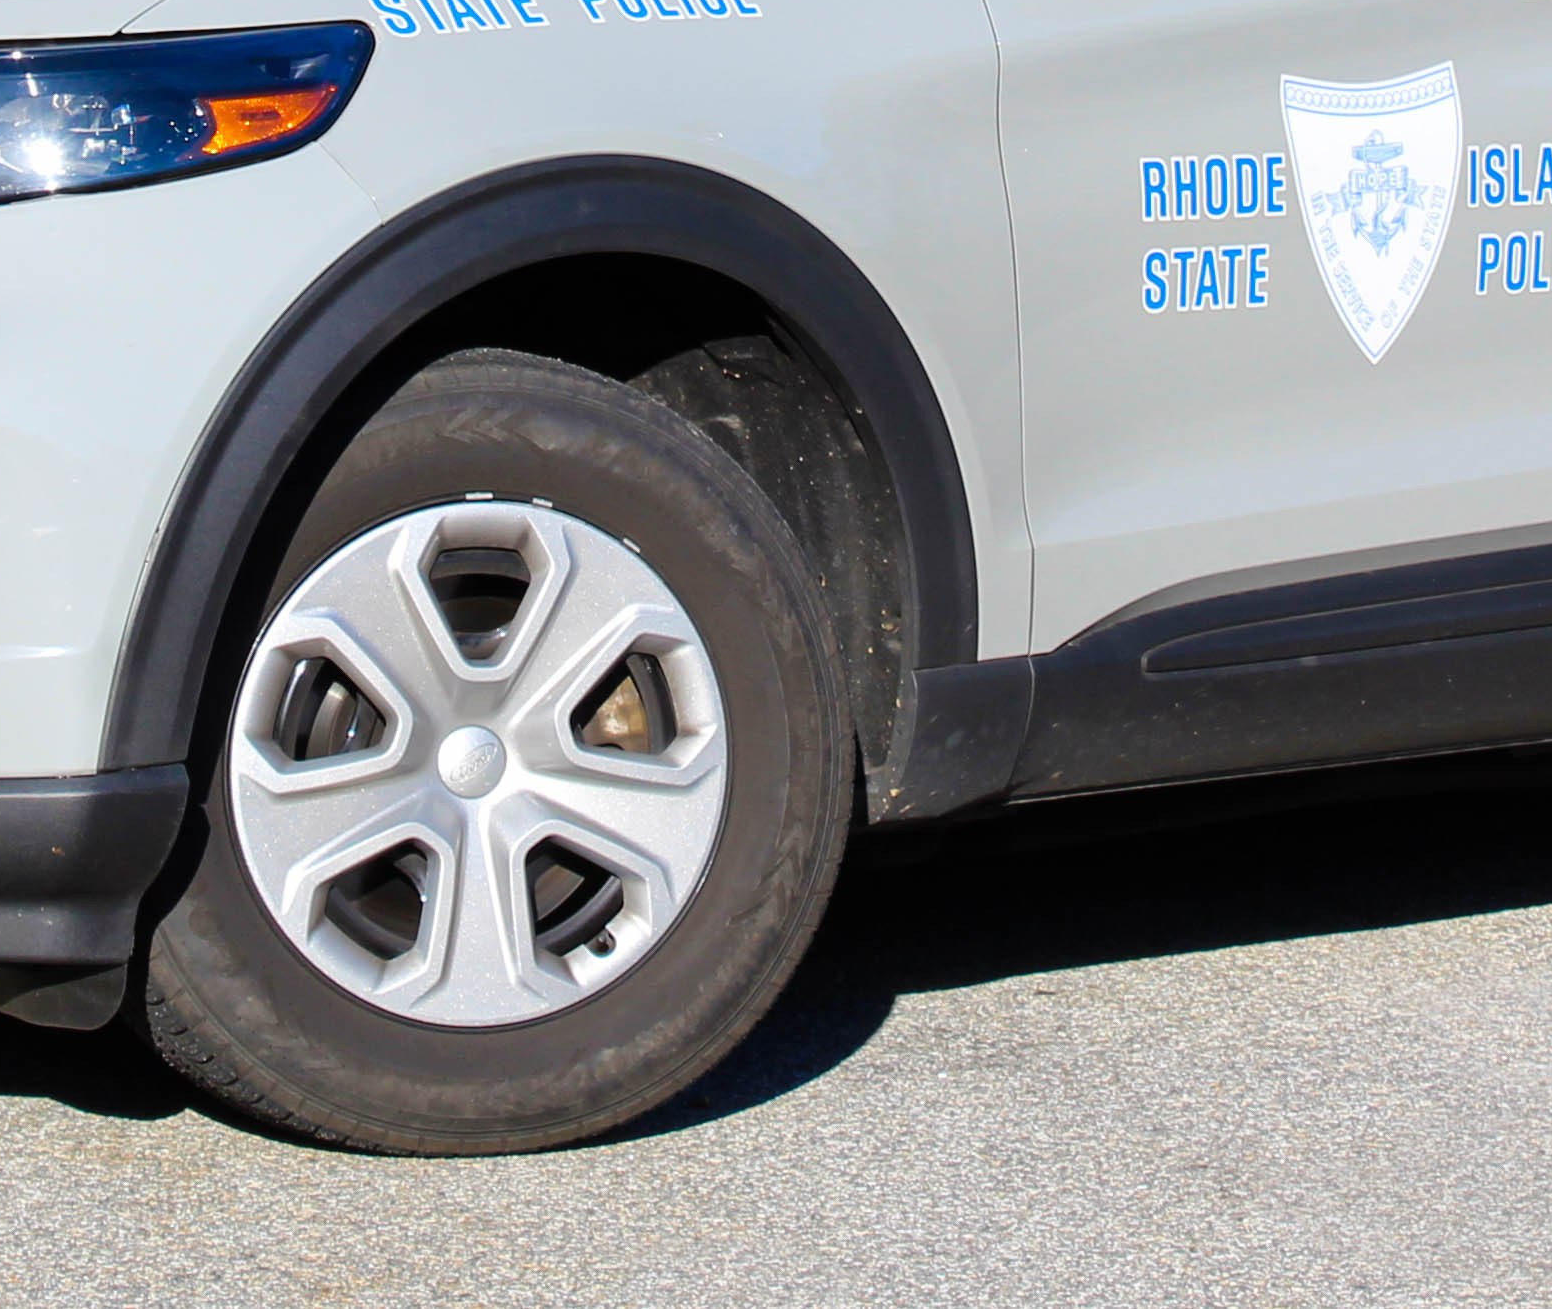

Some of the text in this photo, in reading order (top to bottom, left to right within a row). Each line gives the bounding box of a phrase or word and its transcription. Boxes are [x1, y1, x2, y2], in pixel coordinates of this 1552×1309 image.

[1139, 152, 1288, 223] RHODE
[1358, 170, 1400, 189] HOPE
[1142, 243, 1271, 314] STATE
